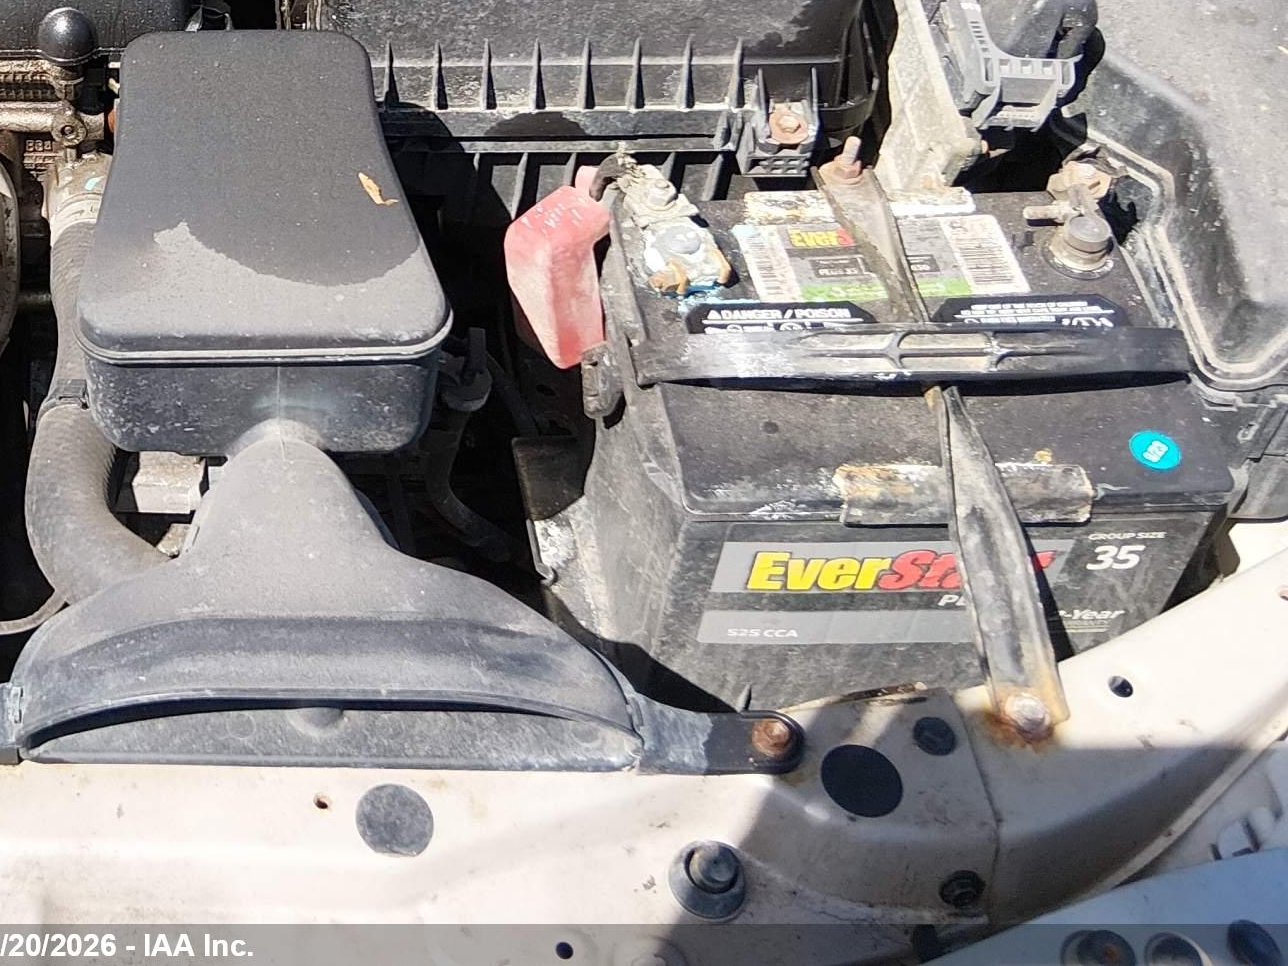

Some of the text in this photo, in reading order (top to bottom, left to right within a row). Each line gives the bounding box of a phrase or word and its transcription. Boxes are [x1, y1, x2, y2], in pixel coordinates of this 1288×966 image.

[721, 310, 783, 320] DANGER
[794, 308, 852, 319] POISON
[1088, 531, 1167, 541] GROUP SIZE
[1086, 545, 1146, 571] 35
[727, 628, 799, 638] 525 CCA
